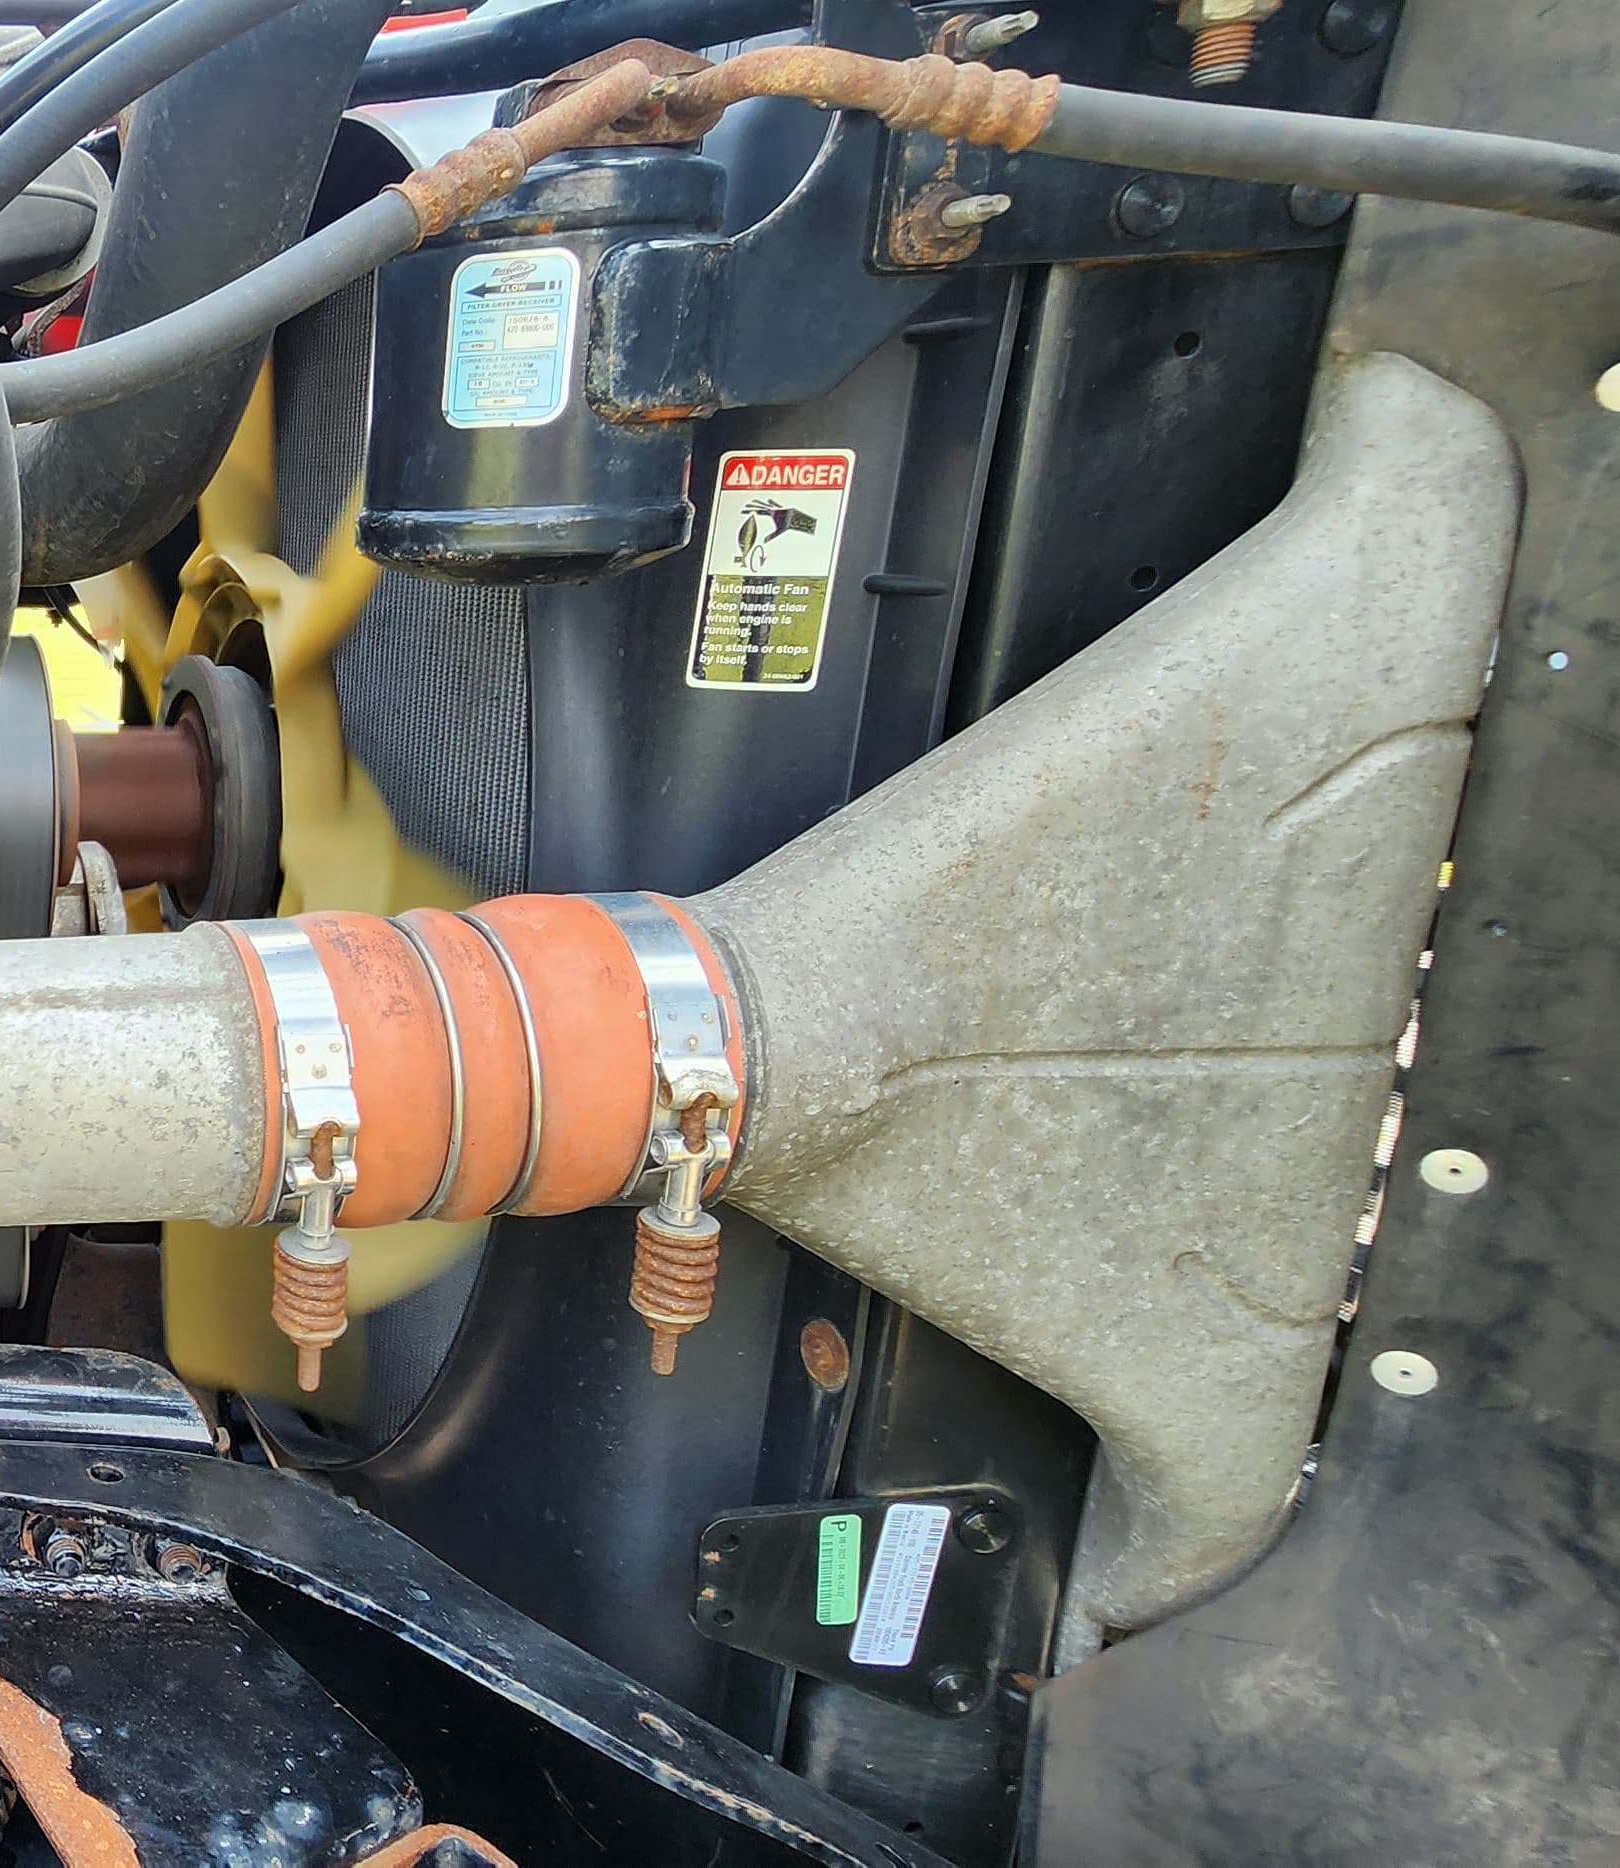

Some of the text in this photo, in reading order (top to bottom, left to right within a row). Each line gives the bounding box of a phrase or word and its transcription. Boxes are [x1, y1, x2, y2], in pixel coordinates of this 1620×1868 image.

[500, 283, 527, 292] FLOW
[751, 465, 845, 486] DANGER
[710, 584, 809, 595] Automatic Fan
[707, 601, 808, 612] Keep hands clear
[706, 614, 792, 626] when engine is
[704, 625, 752, 637] running.
[701, 642, 809, 656] Fan starts or stops
[699, 654, 748, 666] by itself.
[831, 1521, 847, 1532] P
